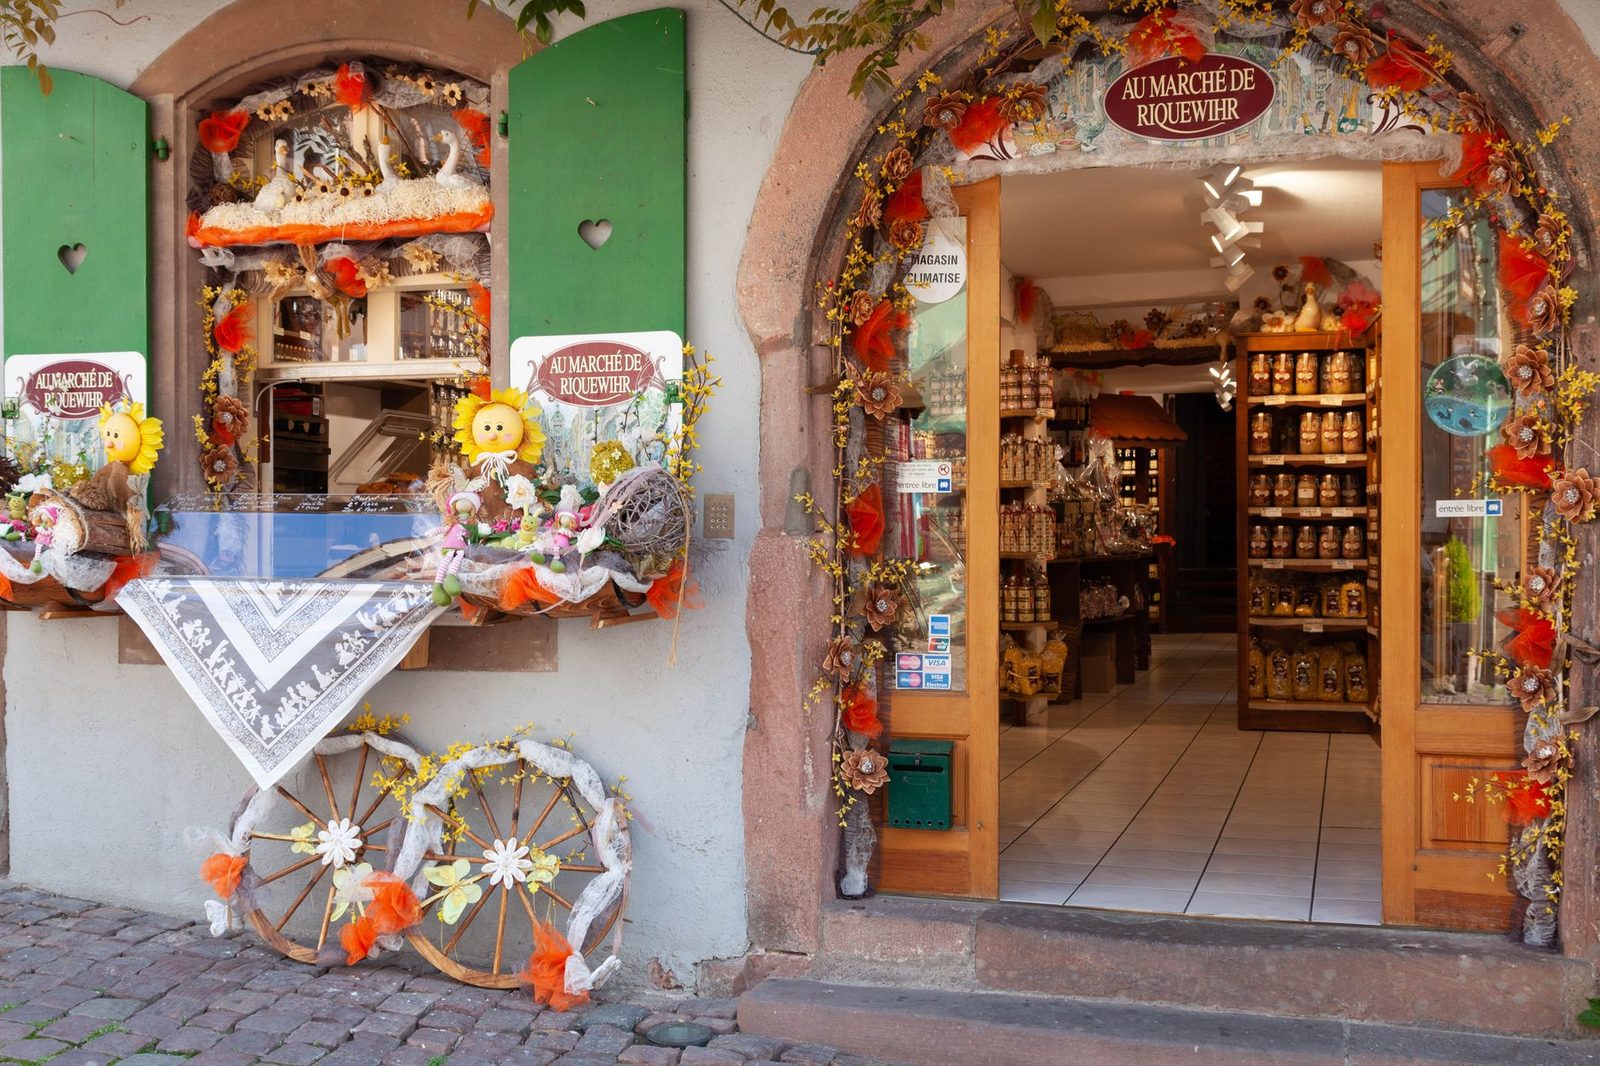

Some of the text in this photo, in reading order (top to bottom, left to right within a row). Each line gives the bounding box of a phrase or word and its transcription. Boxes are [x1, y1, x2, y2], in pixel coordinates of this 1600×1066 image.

[1121, 63, 1256, 100] AU MARCHÉ DE
[1136, 97, 1240, 134] RIQUEWIHR
[911, 254, 958, 265] MAGASIN
[550, 349, 642, 374] AU MARCHÉ DE
[35, 367, 113, 390] AU MARCHÉ DE
[560, 376, 631, 401] RIQUEWIHR
[44, 391, 104, 414] RIQUEWIHR
[898, 481, 920, 489] entrée
[1438, 502, 1485, 513] entrée libre
